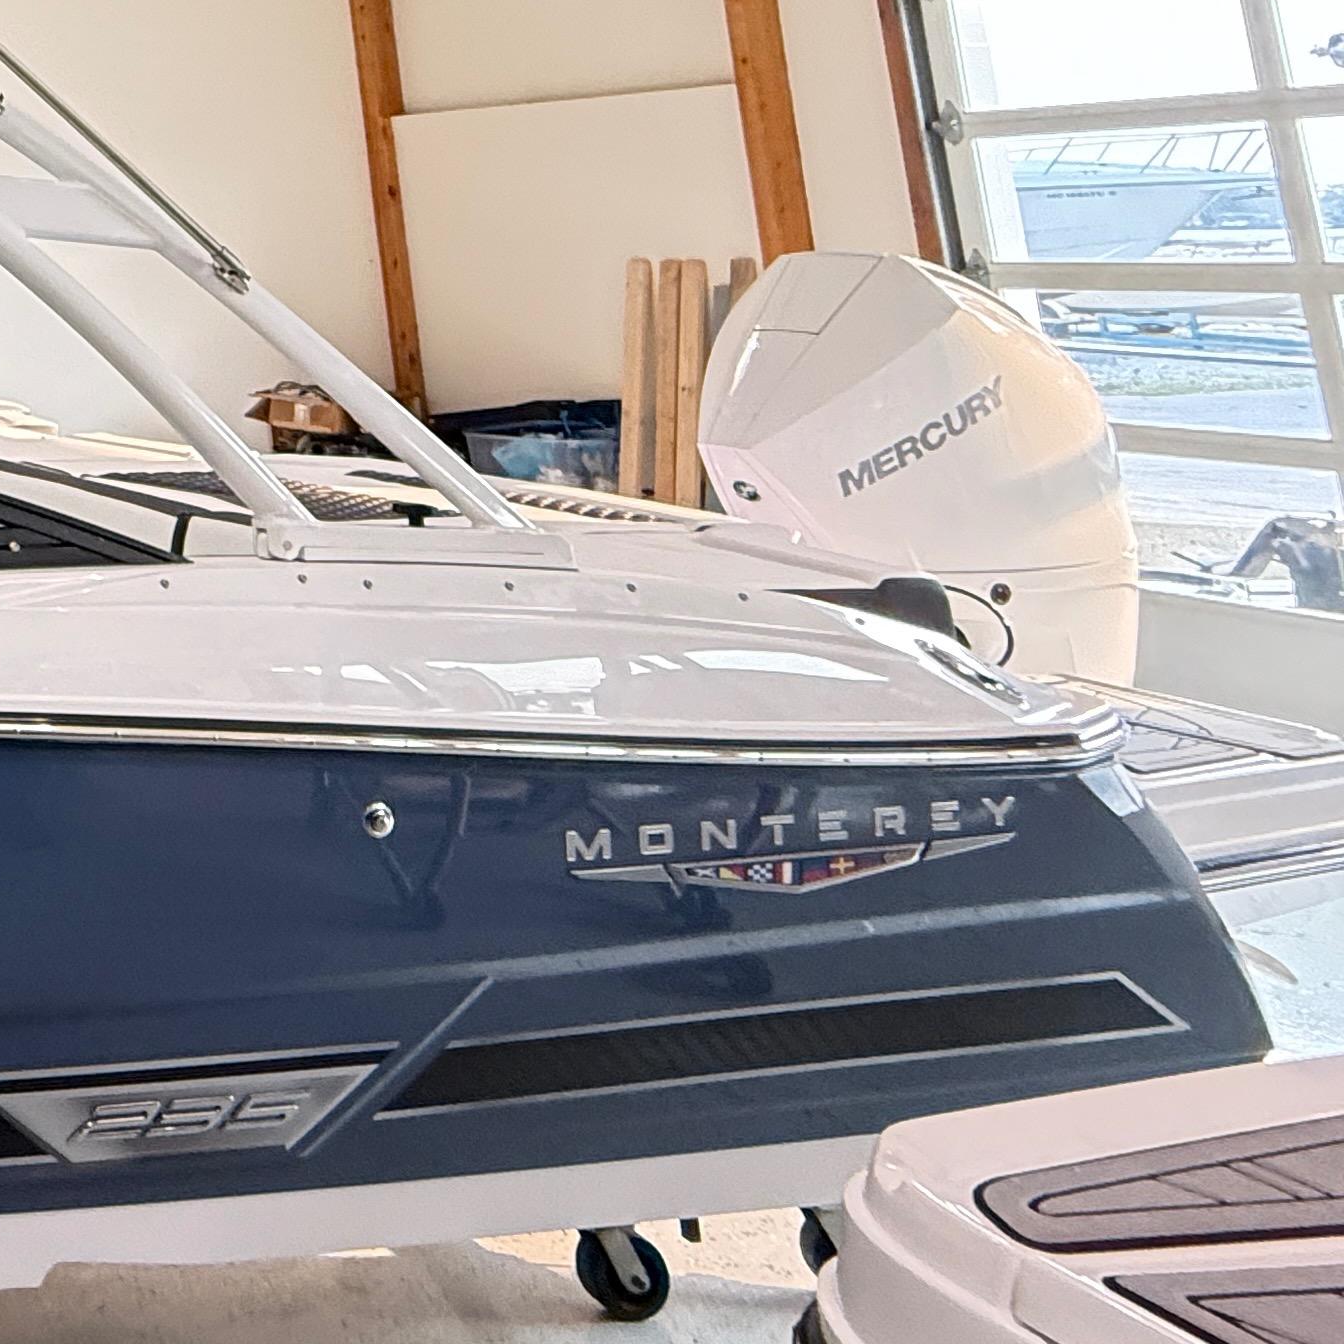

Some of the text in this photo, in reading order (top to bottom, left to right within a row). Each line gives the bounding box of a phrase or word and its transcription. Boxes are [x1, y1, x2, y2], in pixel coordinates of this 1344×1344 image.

[838, 375, 1003, 498] MERCURY
[565, 796, 1016, 862] MONTEREY
[67, 1090, 310, 1141] 235
